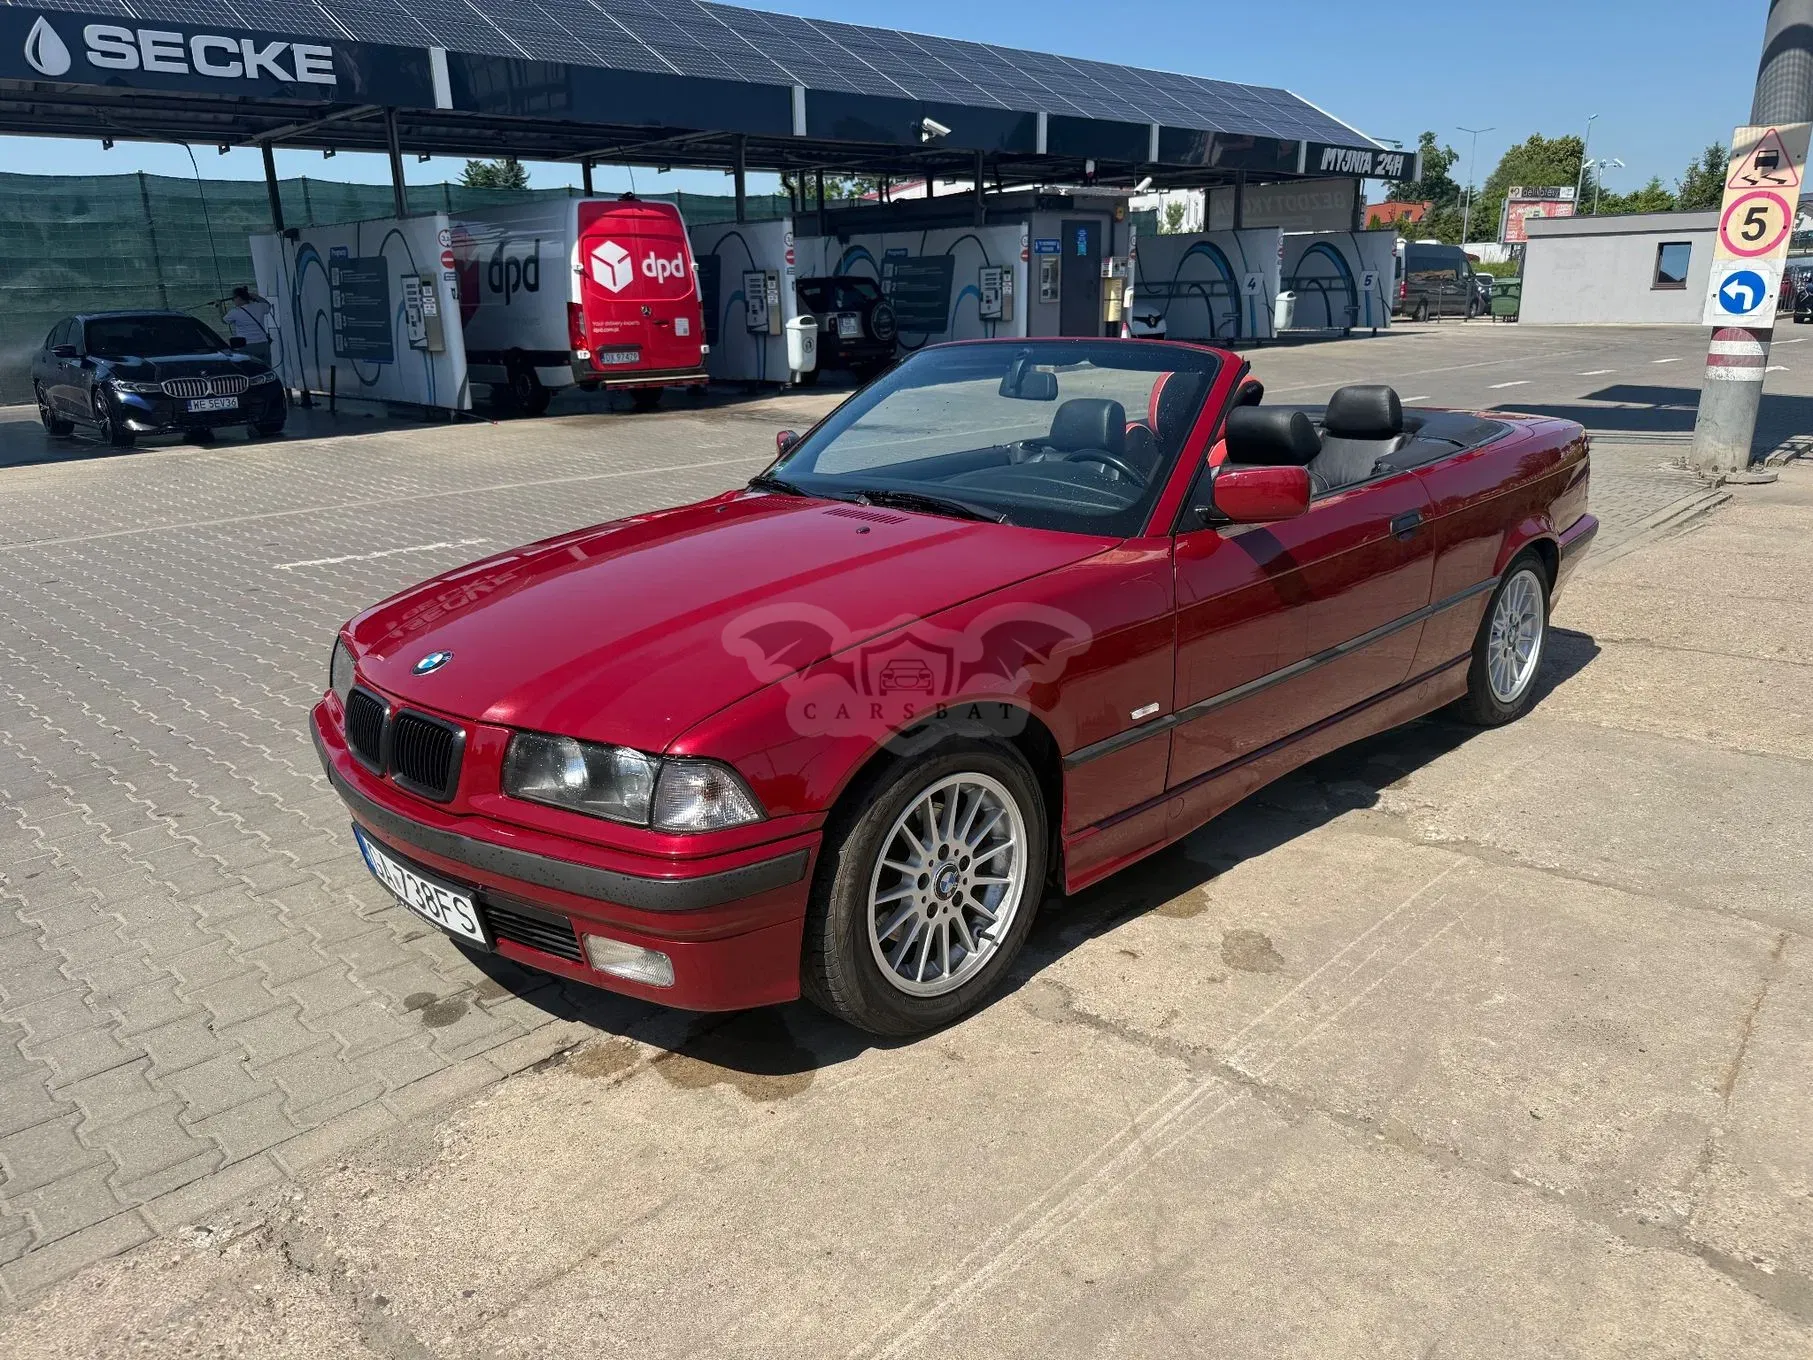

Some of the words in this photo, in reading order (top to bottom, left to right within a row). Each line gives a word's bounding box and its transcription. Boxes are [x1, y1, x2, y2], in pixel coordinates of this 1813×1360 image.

[83, 24, 337, 85] SECKE
[1320, 147, 1373, 174] MYJNIA
[1374, 153, 1404, 176] 24H
[1741, 206, 1769, 242] 5
[488, 239, 540, 306] dpd
[642, 251, 684, 284] dpd
[1247, 277, 1256, 290] 4
[1364, 274, 1373, 286] 5
[393, 863, 477, 935] 738FS
